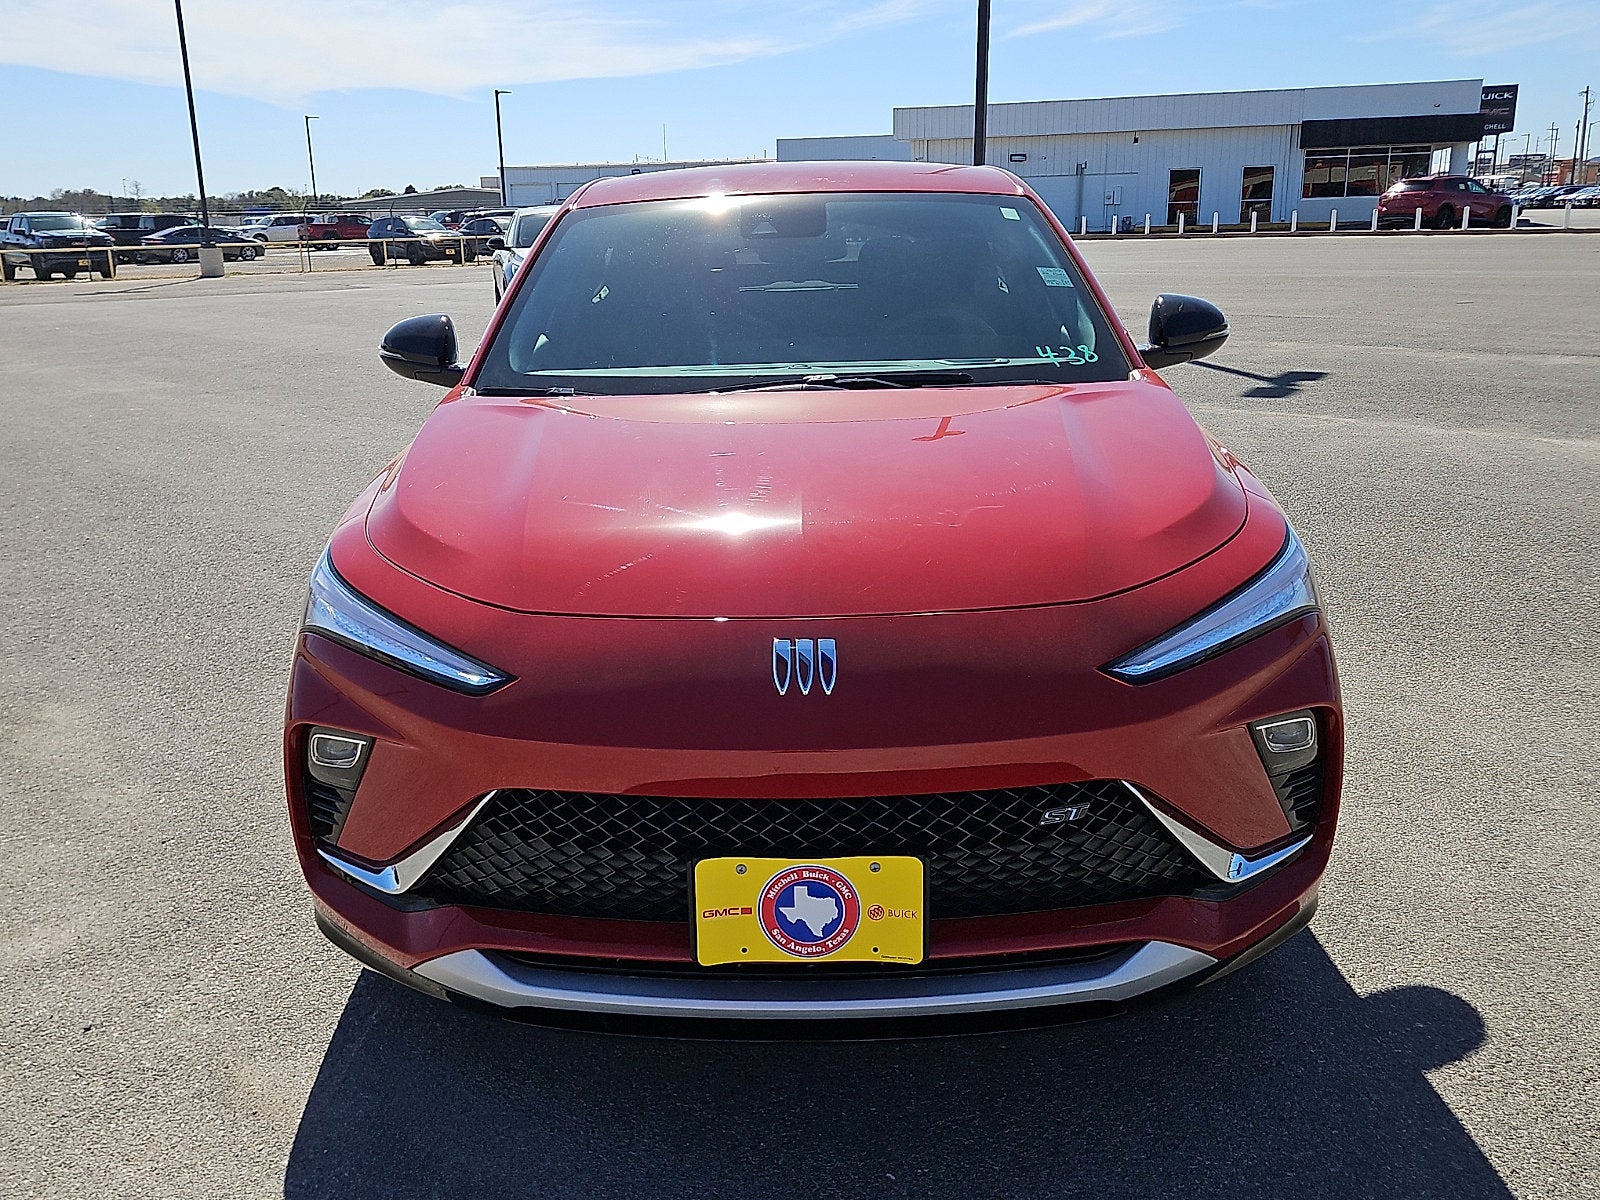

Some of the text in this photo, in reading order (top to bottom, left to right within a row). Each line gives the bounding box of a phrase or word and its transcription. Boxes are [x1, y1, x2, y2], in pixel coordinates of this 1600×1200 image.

[1482, 92, 1514, 100] UICK
[1035, 345, 1099, 367] 438
[1039, 802, 1090, 825] ST
[767, 872, 799, 900] Mitchell
[802, 870, 830, 881] Buick
[835, 881, 853, 900] GMC
[702, 908, 740, 919] GMC
[888, 909, 918, 919] BUICK
[771, 928, 850, 955] San Angelo, Texas
